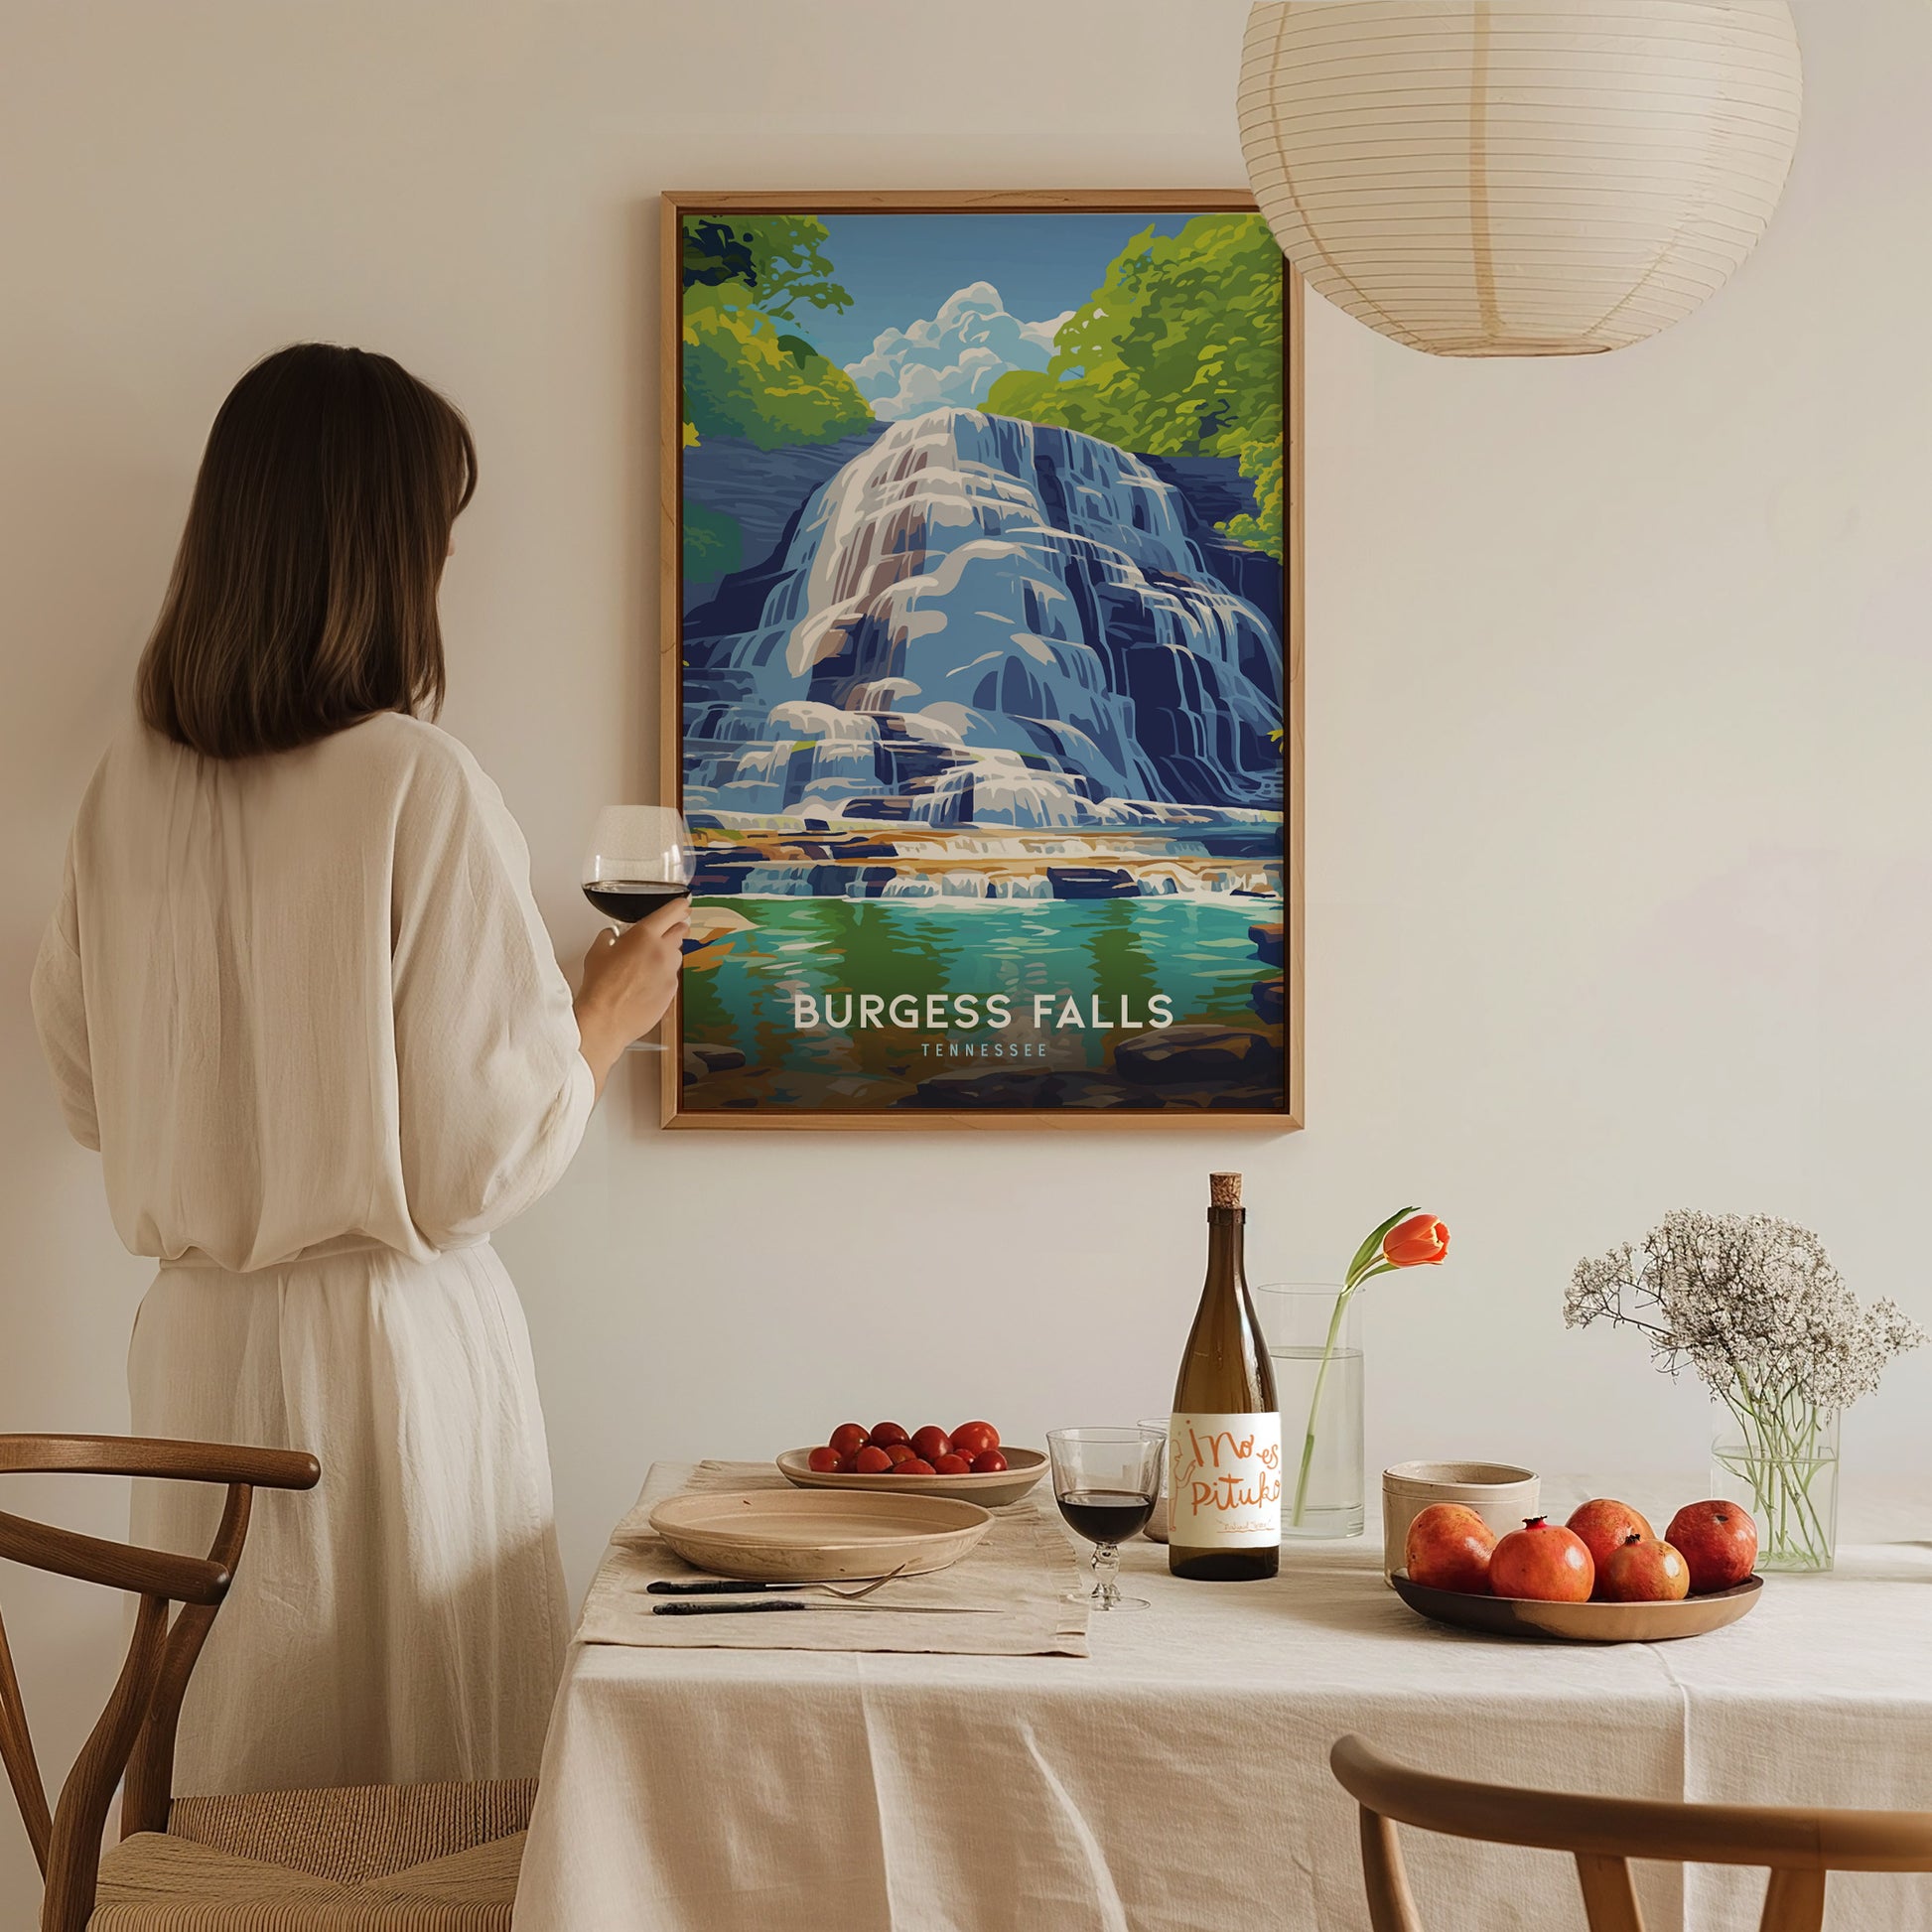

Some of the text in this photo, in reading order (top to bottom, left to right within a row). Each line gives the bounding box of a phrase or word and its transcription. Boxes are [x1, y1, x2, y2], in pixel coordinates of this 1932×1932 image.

[793, 993, 1174, 1030] BURGESS FALLS
[920, 1042, 1046, 1057] TENNESSEE
[1255, 1444, 1279, 1470] es
